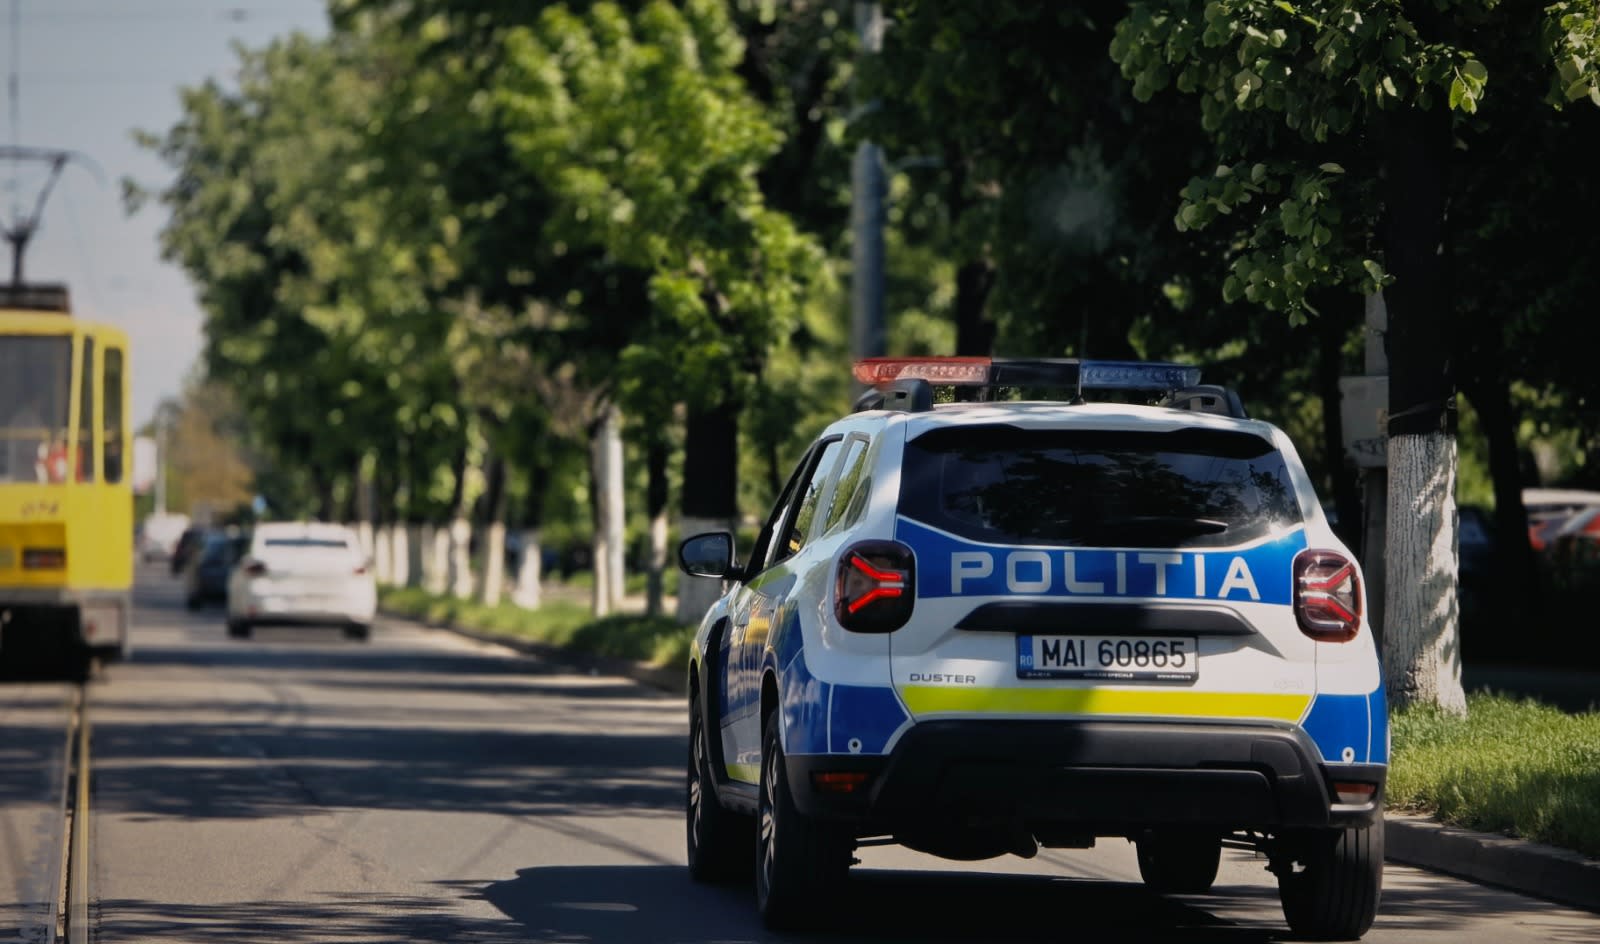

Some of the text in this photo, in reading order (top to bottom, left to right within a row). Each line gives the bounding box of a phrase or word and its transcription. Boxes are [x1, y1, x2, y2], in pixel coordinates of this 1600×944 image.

[951, 552, 1261, 600] POLITIA
[1020, 655, 1033, 666] RO
[1042, 639, 1186, 668] MAI 60865
[909, 673, 976, 684] DUSTER
